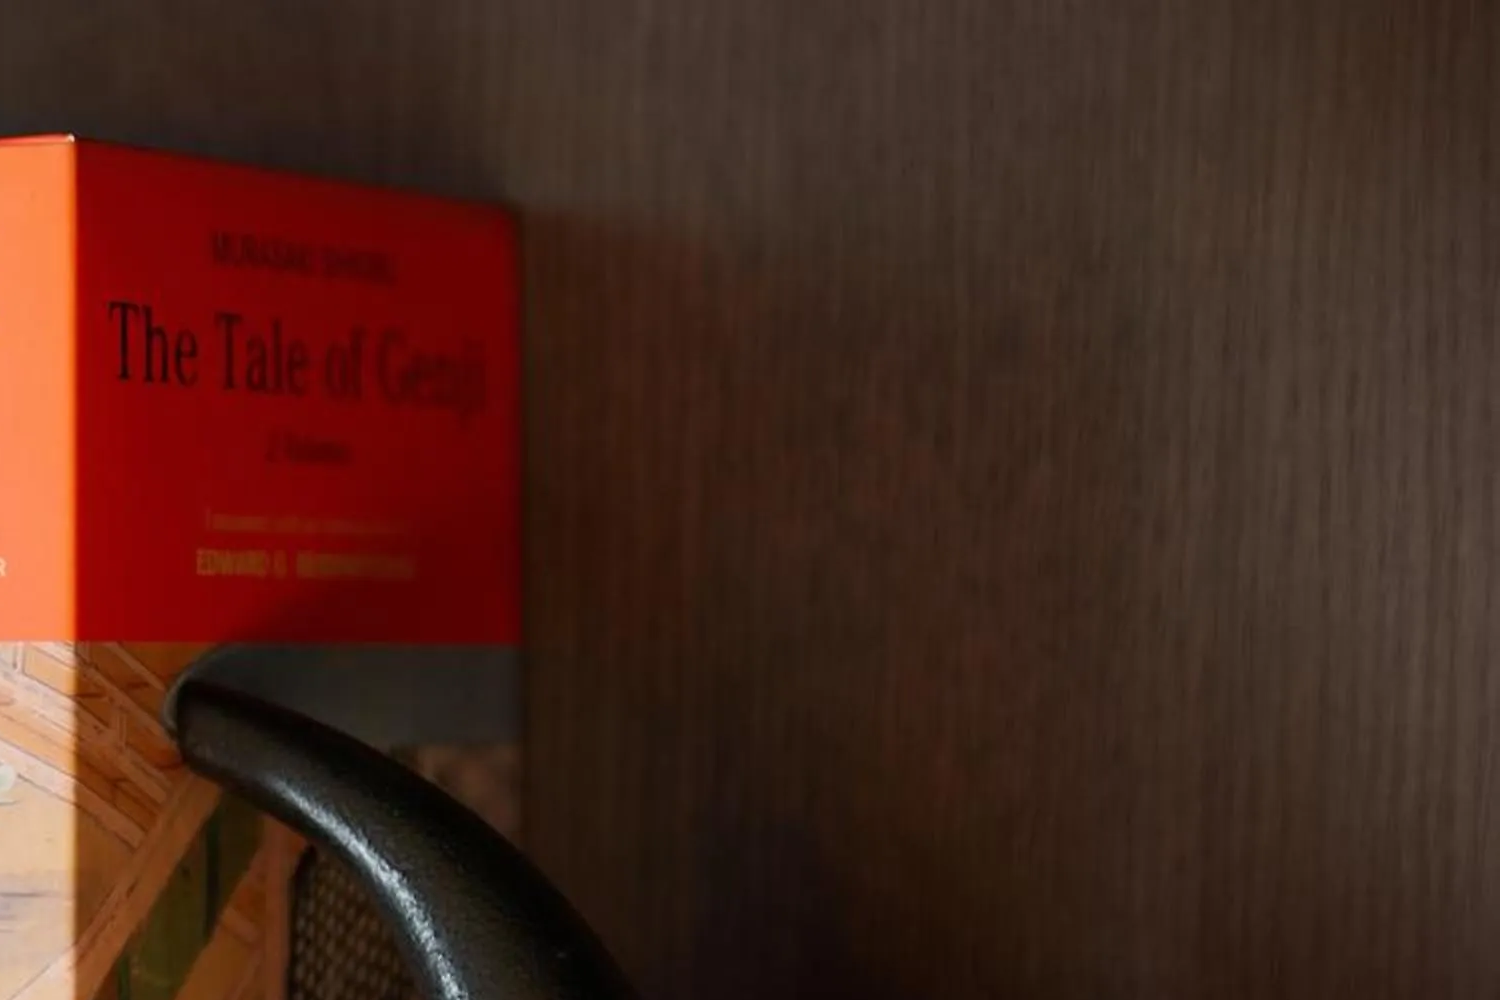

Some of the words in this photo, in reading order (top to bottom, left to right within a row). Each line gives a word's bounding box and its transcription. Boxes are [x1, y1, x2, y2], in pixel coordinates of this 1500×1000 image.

[109, 300, 199, 388] The
[214, 311, 312, 396] Tale
[323, 325, 367, 402] of
